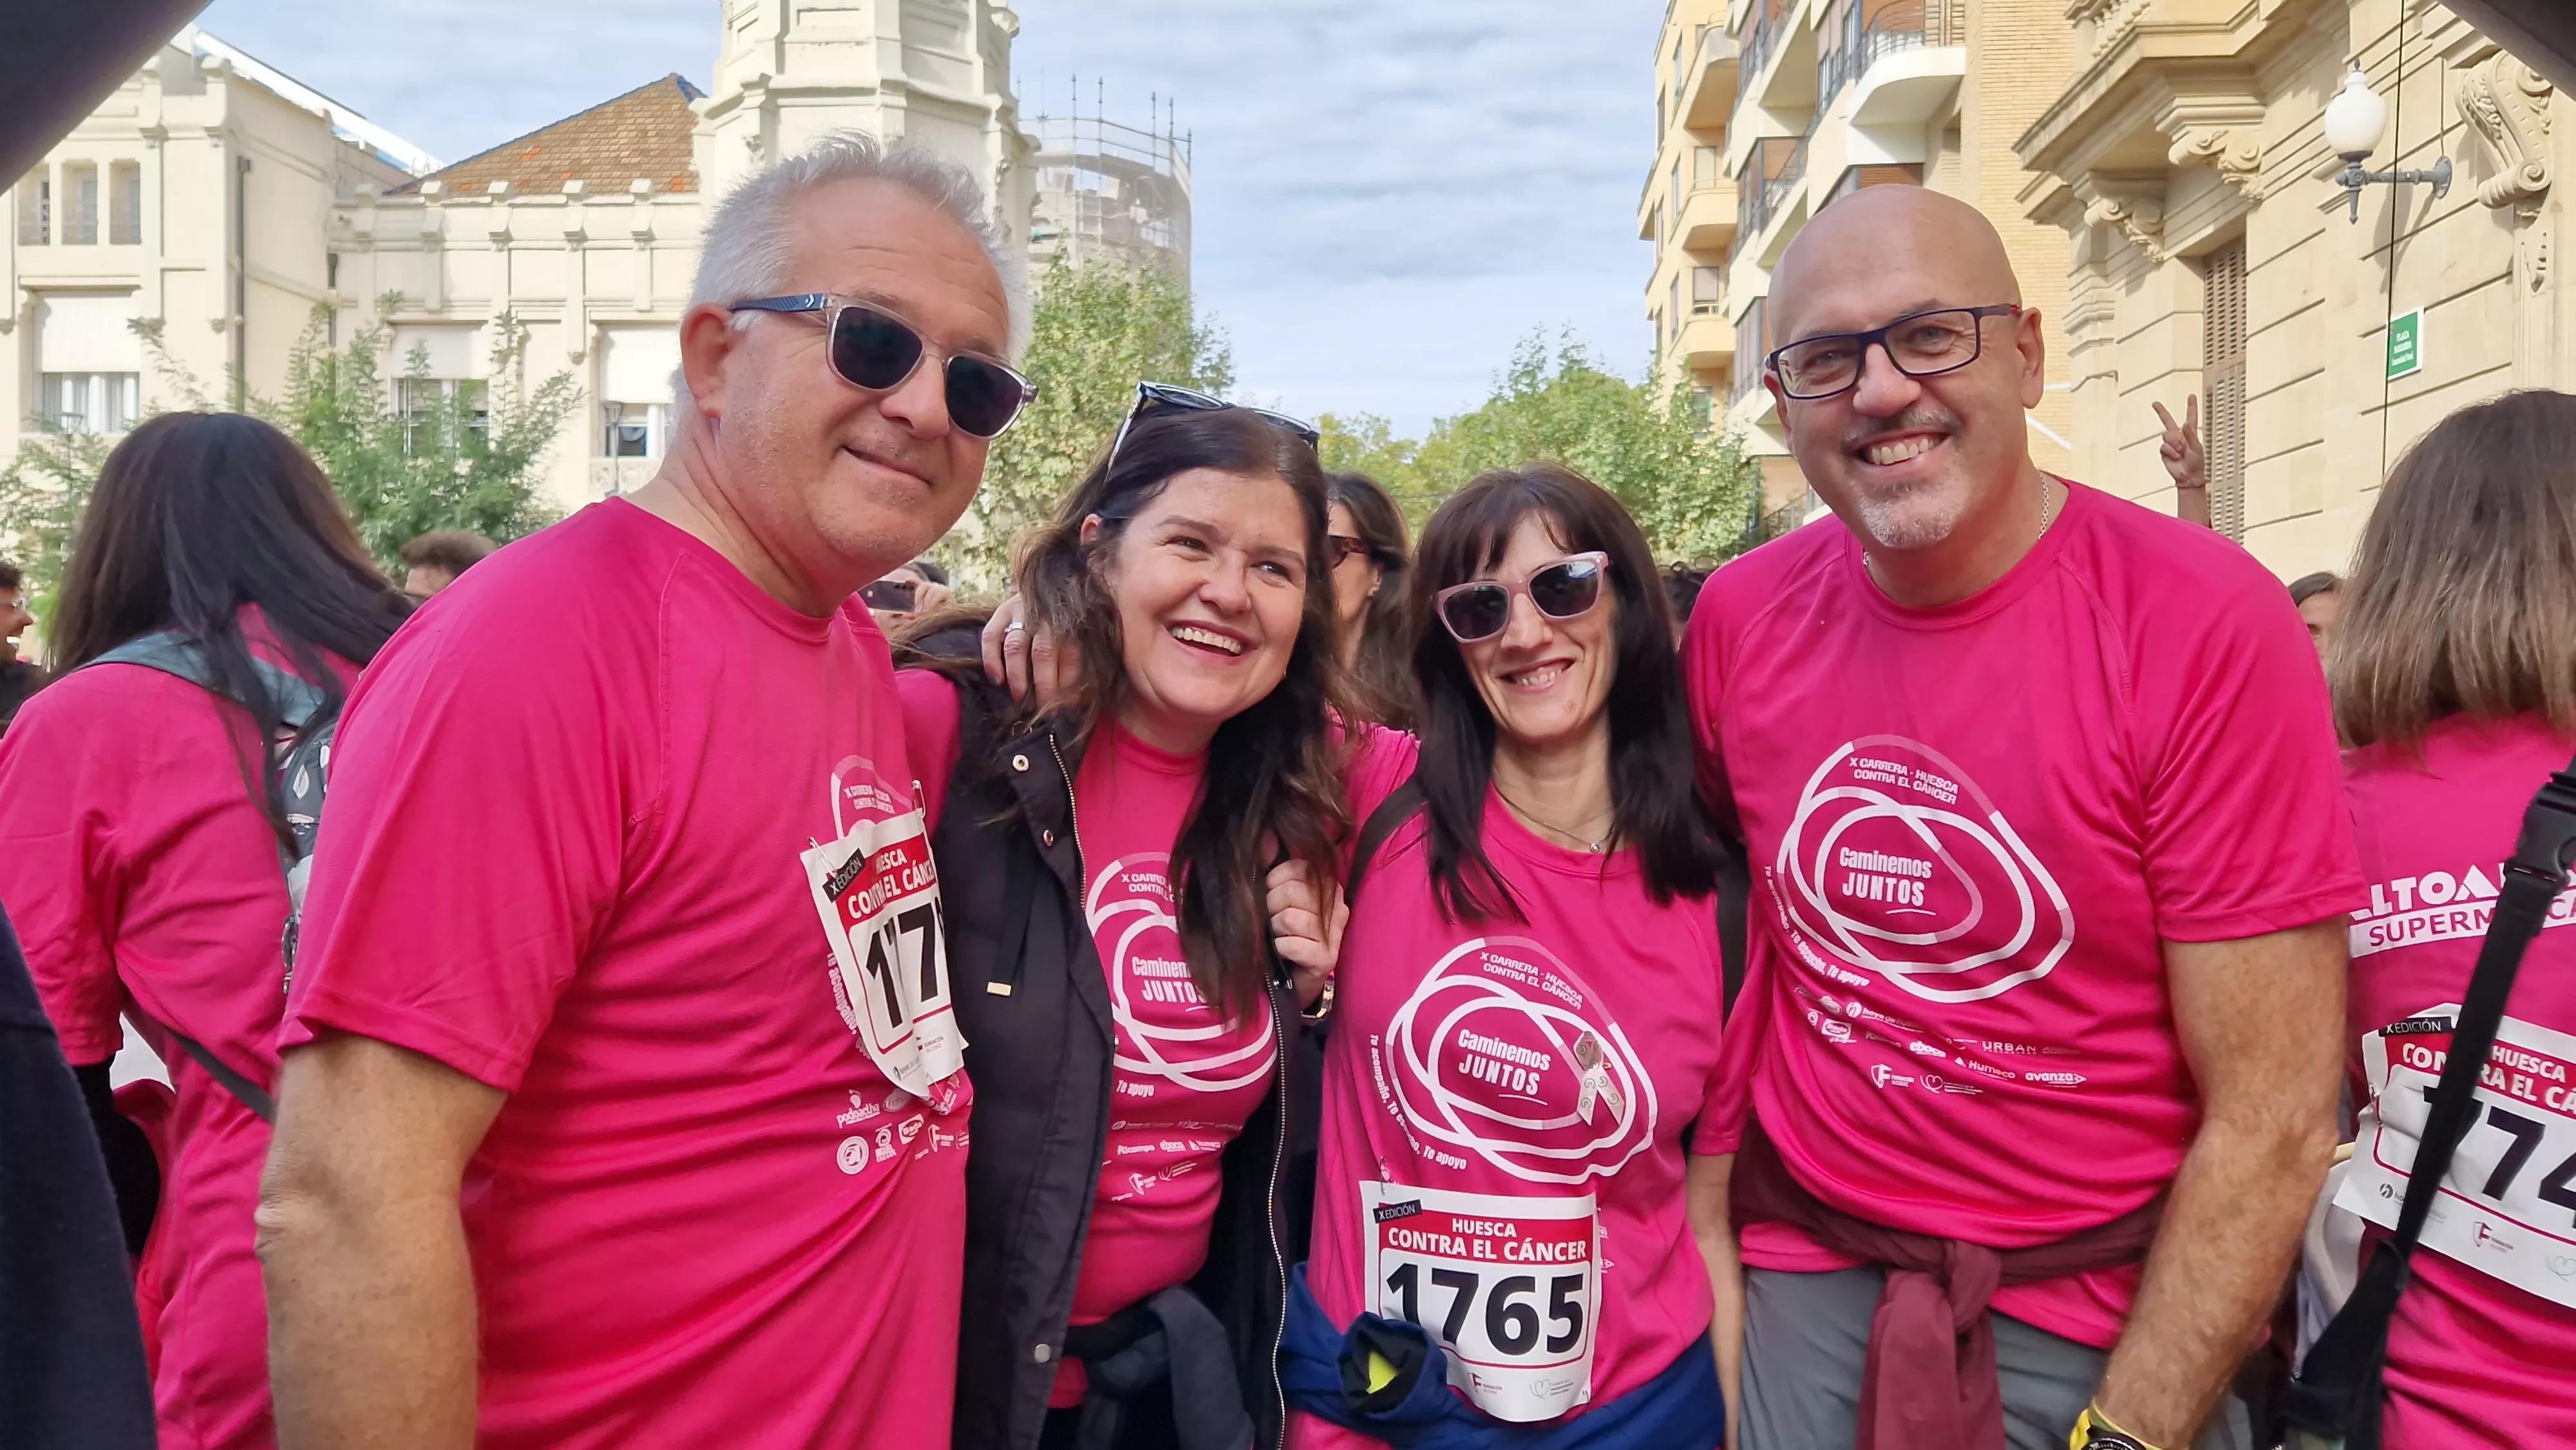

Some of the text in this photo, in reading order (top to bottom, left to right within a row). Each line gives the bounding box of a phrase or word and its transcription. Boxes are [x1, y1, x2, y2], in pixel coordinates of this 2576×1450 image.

[1849, 757, 1858, 767] X
[1860, 758, 1908, 776] CARRERA
[1915, 769, 1958, 795] HUESCA
[1854, 769, 1895, 784] CONTRA
[1897, 777, 1911, 788] EL
[1839, 847, 1932, 878] Caminemos
[883, 874, 902, 898] EL
[1121, 874, 1130, 883] X
[1842, 872, 1925, 907] JUNTOS
[2350, 863, 2507, 921] LTOA
[866, 898, 944, 1028] 17
[1132, 956, 1192, 978] Caminem
[1480, 952, 1489, 961] X
[1490, 954, 1538, 975] CARRERA
[1546, 972, 1583, 1003] HUESCA
[1483, 963, 1525, 982] CONTRA
[1527, 976, 1540, 987] EL
[1827, 965, 1839, 978] Te
[1837, 969, 1870, 986] apoyo
[1458, 1029, 1551, 1070] Caminemos
[1982, 1040, 2036, 1051] URBAN
[1459, 1053, 1540, 1095] JUNTOS
[1969, 1060, 2016, 1078] Humeco
[2025, 1072, 2073, 1082] avanza
[2492, 1045, 2566, 1083] HUESCA
[1116, 1080, 1154, 1097] Te apoyo
[2510, 1073, 2537, 1102] EL
[1387, 1101, 1398, 1115] Te
[1423, 1145, 1435, 1160] Te
[1435, 1153, 1467, 1170] apoyo
[1452, 1218, 1517, 1238] HUESCA
[1388, 1227, 1586, 1262] CONTRA EL CÁNCER
[1387, 1263, 1583, 1355] 1765
